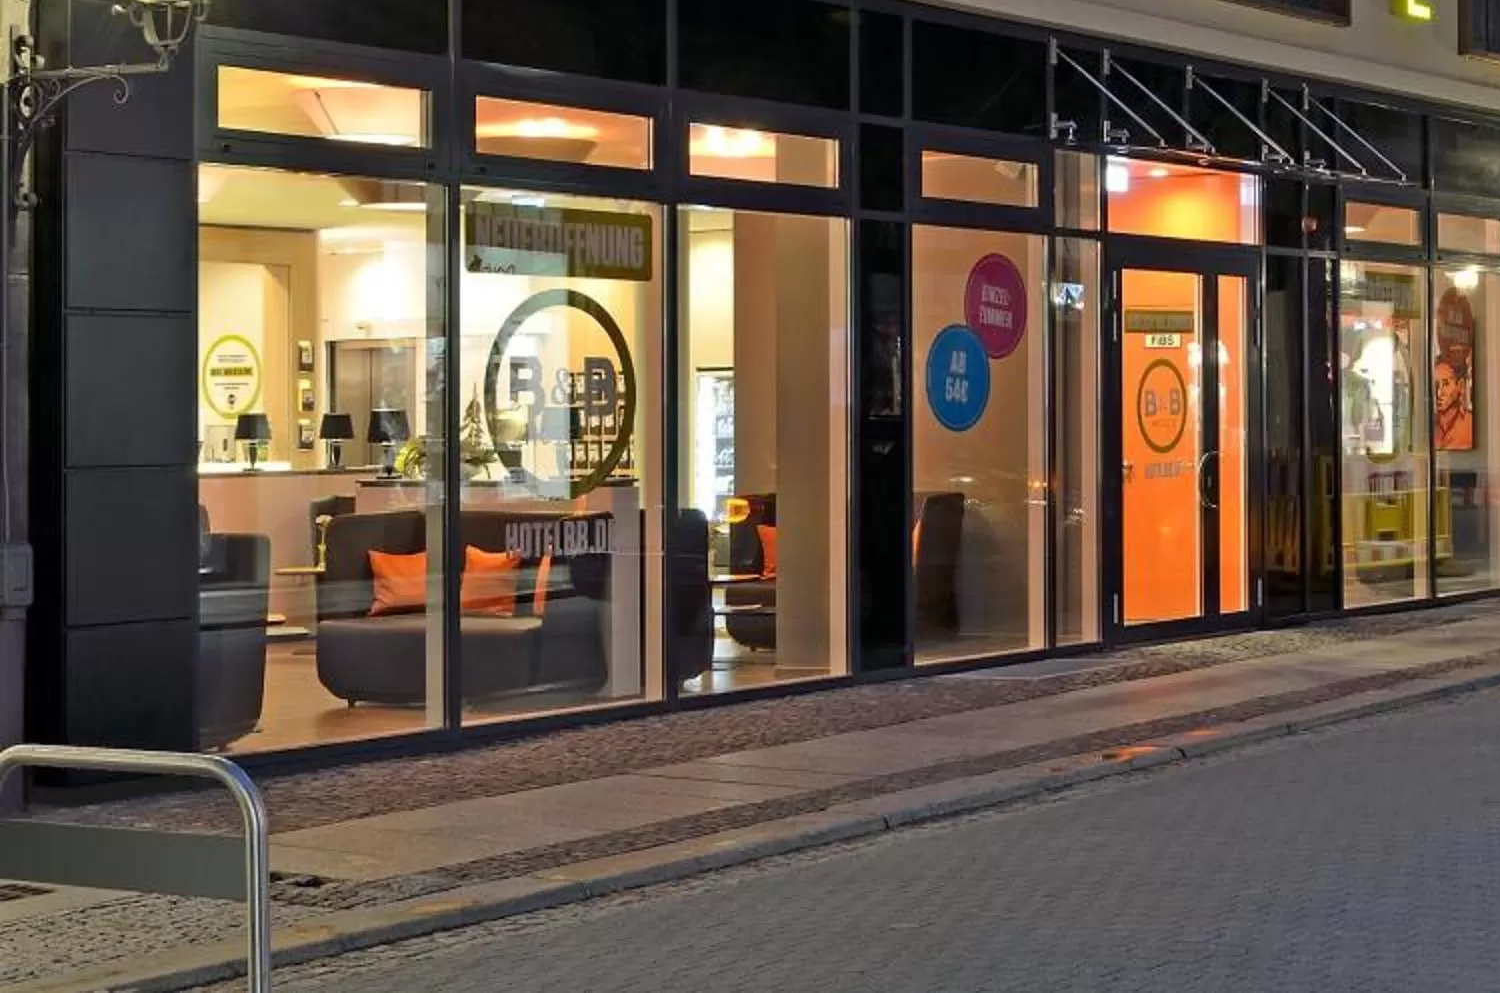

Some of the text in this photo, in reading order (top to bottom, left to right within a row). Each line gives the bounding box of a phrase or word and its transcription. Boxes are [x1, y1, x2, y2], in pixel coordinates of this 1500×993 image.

[950, 350, 967, 374] AB
[509, 356, 617, 418] B&B
[1145, 390, 1181, 416] BB
